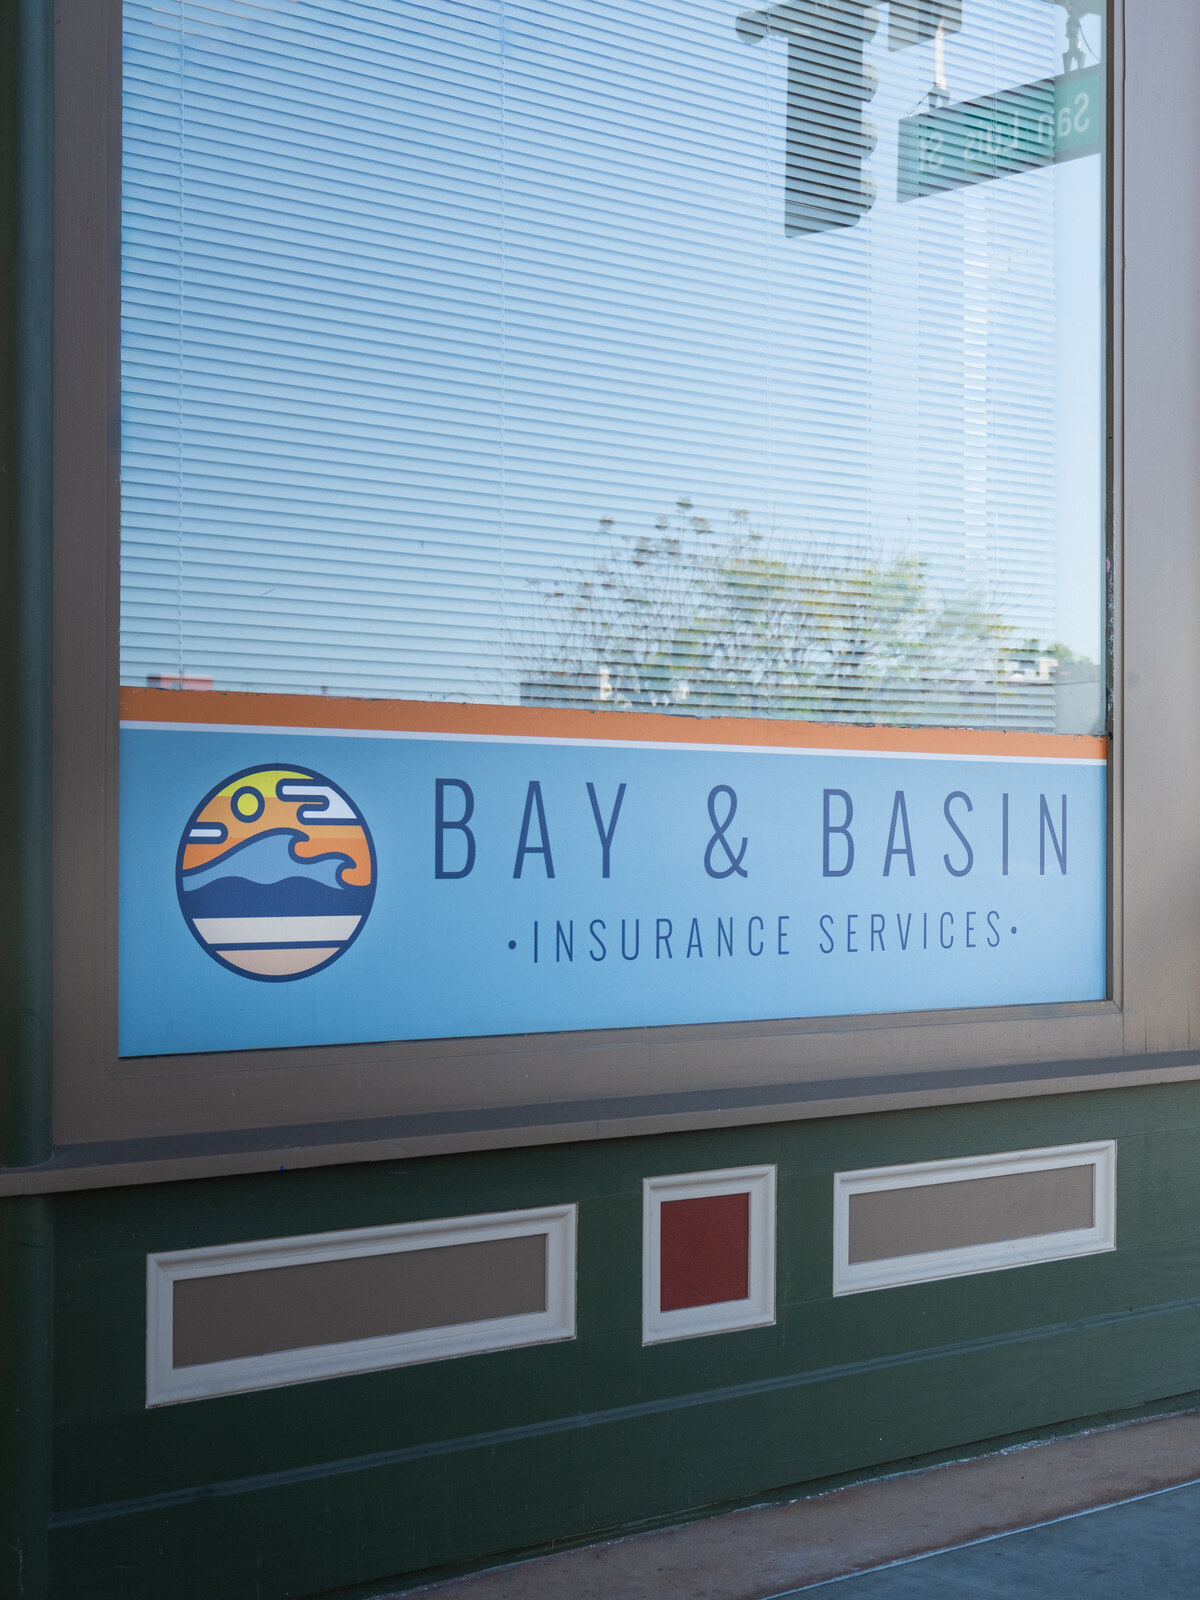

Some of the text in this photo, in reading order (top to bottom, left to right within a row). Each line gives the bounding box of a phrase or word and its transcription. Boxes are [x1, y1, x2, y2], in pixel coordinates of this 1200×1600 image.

[434, 778, 1068, 880] BAY & BASIN
[533, 910, 1001, 963] INSURANCE SERVICES
